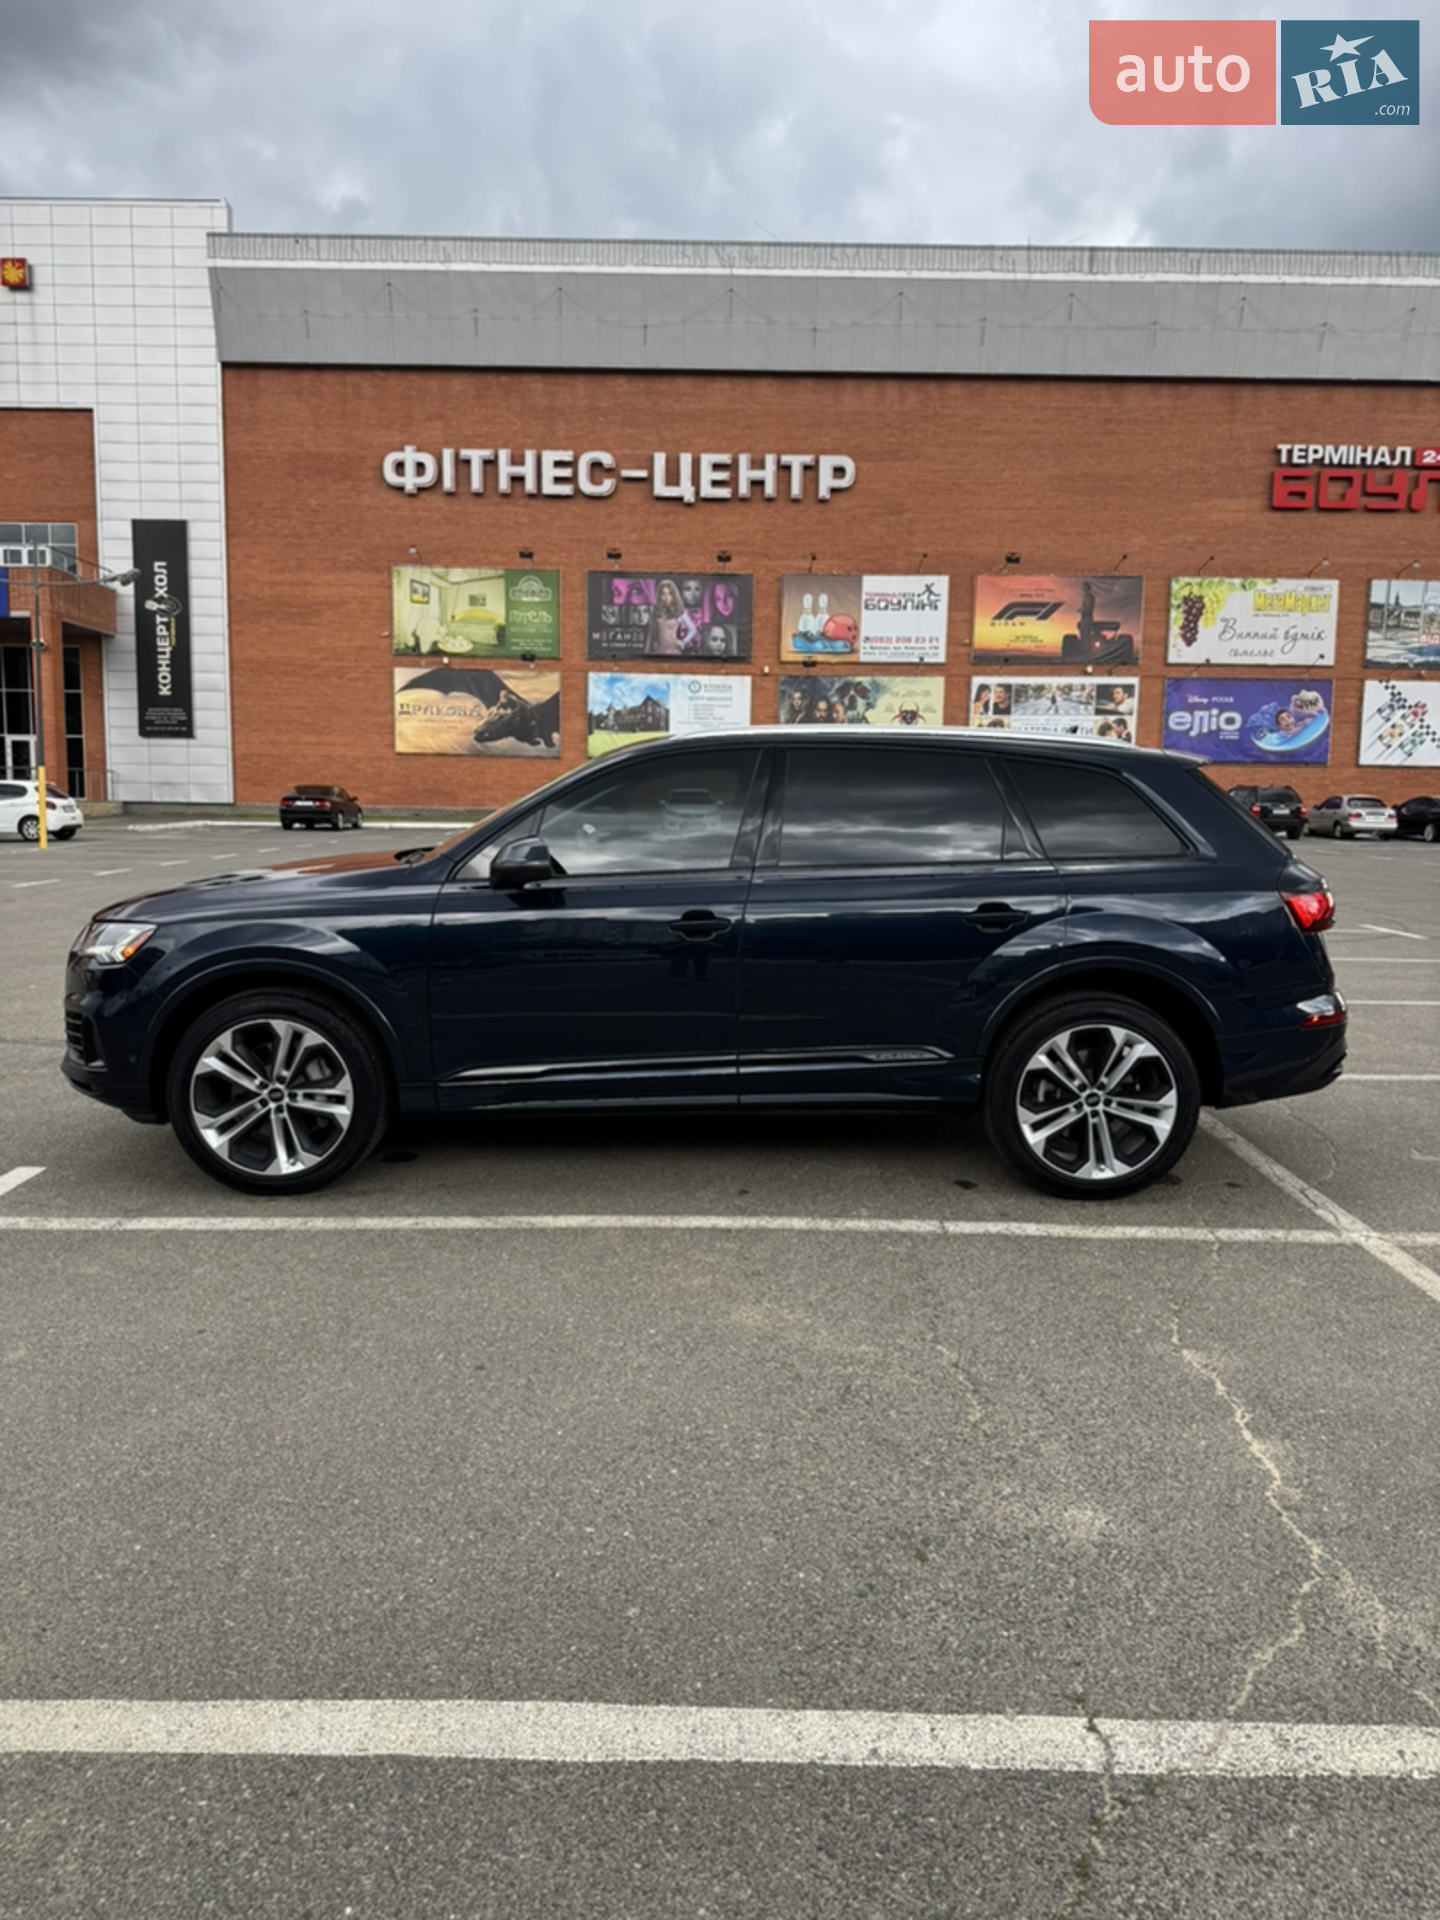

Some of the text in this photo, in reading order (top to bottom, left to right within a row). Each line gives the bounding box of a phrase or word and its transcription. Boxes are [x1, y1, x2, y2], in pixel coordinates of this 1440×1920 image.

[382, 445, 857, 504] ФІТНЕС-ЦЕНТР
[1276, 443, 1412, 467] ТЕРМІНАЛ
[153, 561, 173, 696] КОНЦЕРТ ХОЛ
